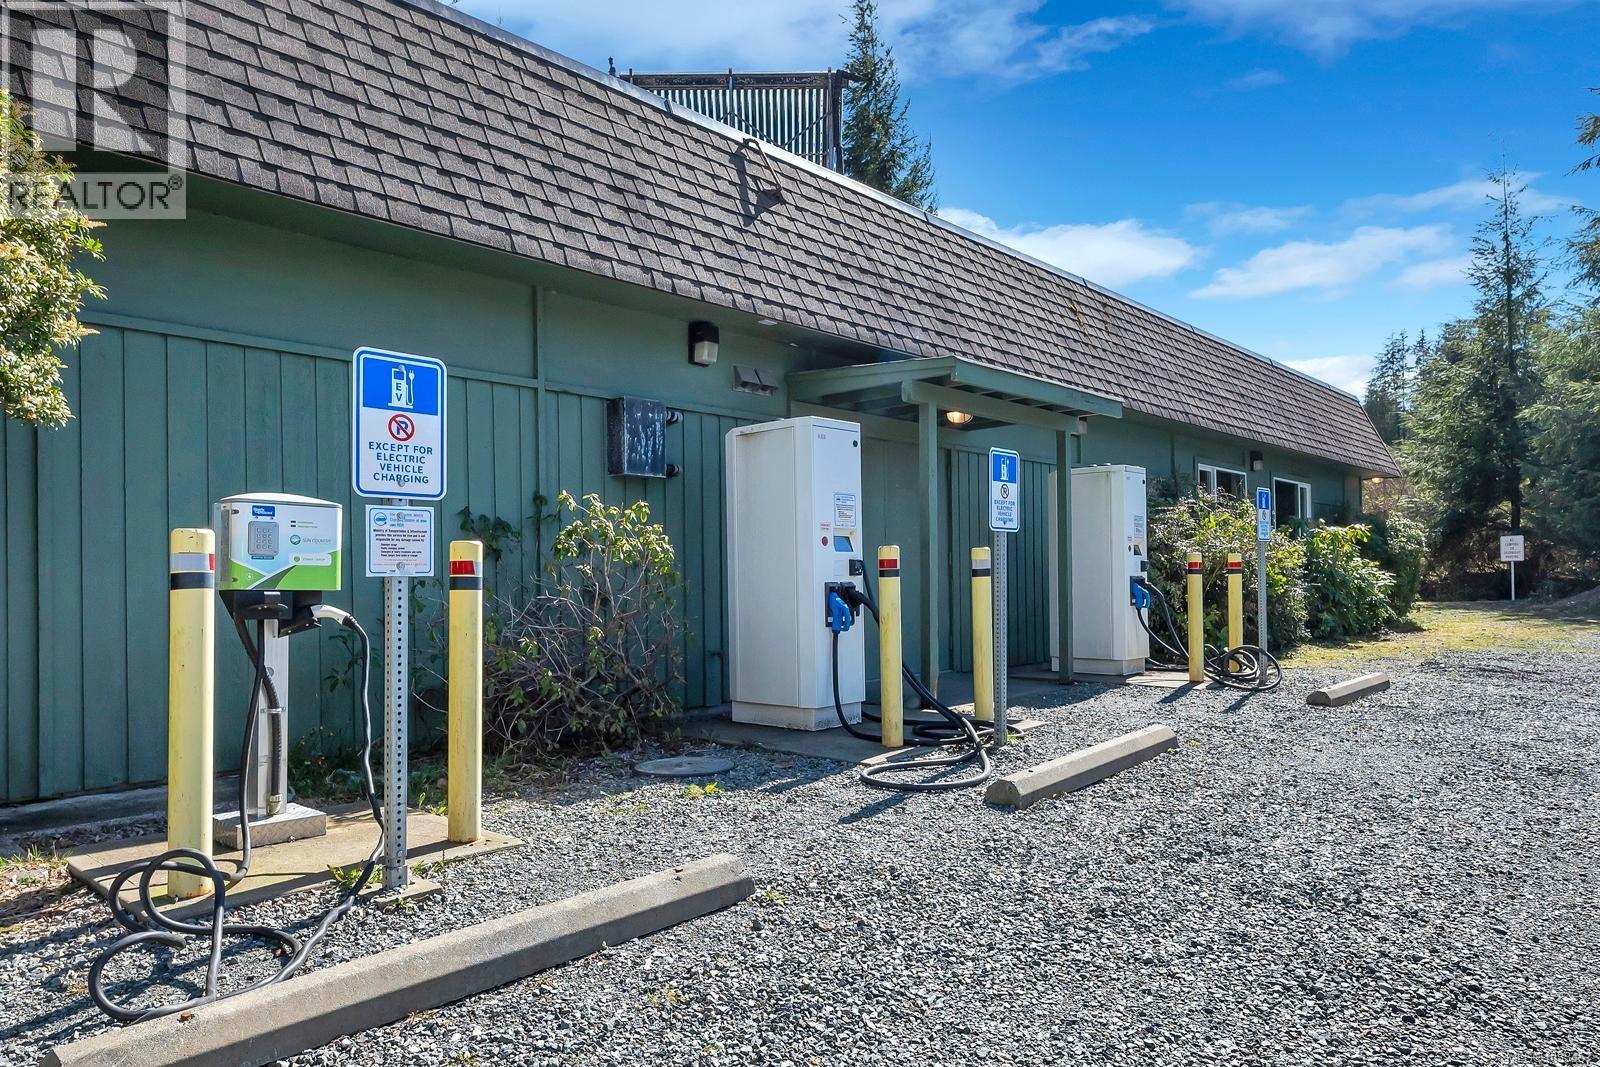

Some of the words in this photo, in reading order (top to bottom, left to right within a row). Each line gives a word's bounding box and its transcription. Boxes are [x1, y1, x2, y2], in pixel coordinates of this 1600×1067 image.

[368, 441, 410, 453] EXCEPT
[413, 445, 433, 455] FOR
[376, 452, 426, 464] ELECTRIC
[379, 463, 424, 474] VEHICLE
[373, 472, 429, 484] CHARGING
